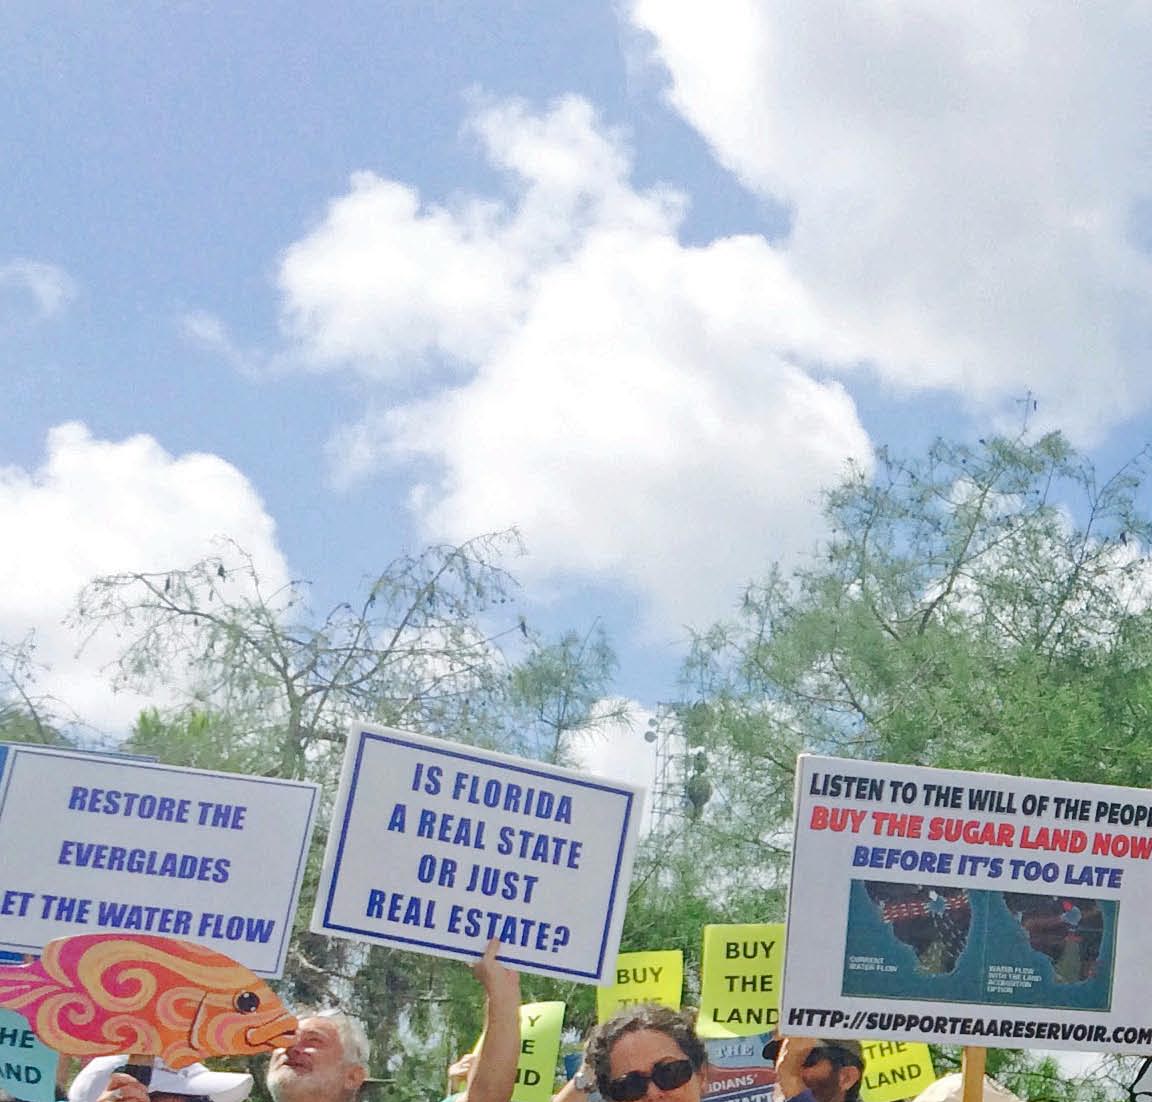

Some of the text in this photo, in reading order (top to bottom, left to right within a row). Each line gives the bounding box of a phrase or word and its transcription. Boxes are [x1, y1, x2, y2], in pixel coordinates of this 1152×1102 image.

[68, 786, 248, 830] RESTORE THE
[412, 763, 573, 825] IS FLORIDA
[809, 772, 885, 803] LISTEN
[889, 781, 918, 804] TO
[924, 784, 965, 809] THE
[968, 788, 1017, 815] WILL
[1022, 794, 1050, 817] OF
[1053, 797, 1090, 821] THE
[387, 803, 583, 869] A REAL STATE
[810, 805, 867, 833] BUY
[872, 810, 923, 838] THE
[928, 817, 1016, 848] SUGAR
[1020, 825, 1087, 855] LAND
[58, 840, 231, 883] EVERGLADES
[417, 854, 539, 904] OR JUST
[852, 845, 1124, 889] BEFORE IT'S TOO LATE
[1, 890, 276, 943] ET THE WATER FLOW
[366, 889, 571, 953] REAL ESTATE?
[726, 941, 776, 960] BUY
[617, 967, 663, 984] BUY
[724, 974, 773, 992] THE
[712, 1007, 779, 1026] LAND
[787, 1007, 1152, 1046] HTTP://SUPPORTEAARESERVOIR.COM
[0, 1027, 34, 1048] HE
[719, 1043, 754, 1058] THE
[866, 1041, 908, 1061] THE
[0, 1062, 42, 1084] ND
[865, 1063, 922, 1090] LAND
